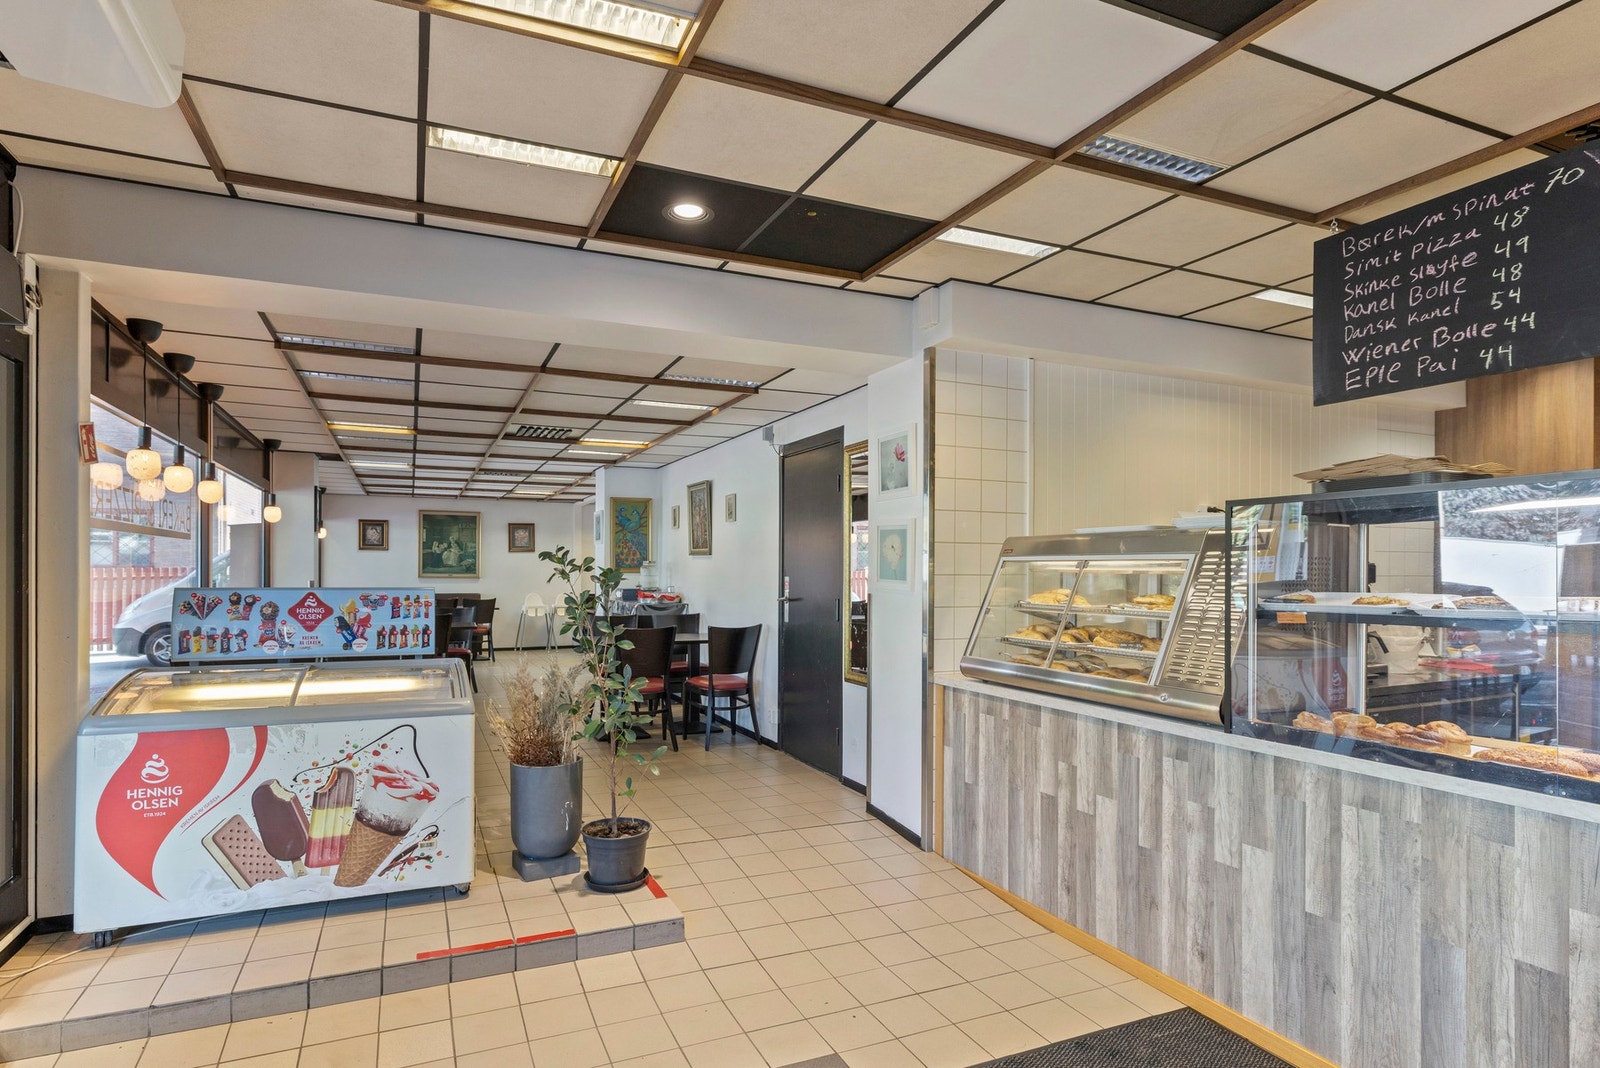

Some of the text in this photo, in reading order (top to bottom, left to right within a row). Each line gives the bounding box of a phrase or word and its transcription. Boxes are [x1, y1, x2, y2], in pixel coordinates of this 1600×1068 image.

[1544, 167, 1586, 194] 70
[1494, 206, 1529, 232] 48
[1495, 235, 1529, 258] 49
[1409, 276, 1467, 307] Bolle
[1492, 263, 1522, 283] 48
[1490, 287, 1521, 311] 54
[1433, 322, 1497, 348] Bolle
[1503, 311, 1536, 333] 44
[1417, 348, 1459, 378] Pai
[1479, 344, 1513, 370] 44
[126, 785, 183, 800] HENNIG
[131, 797, 179, 811] OLSEN
